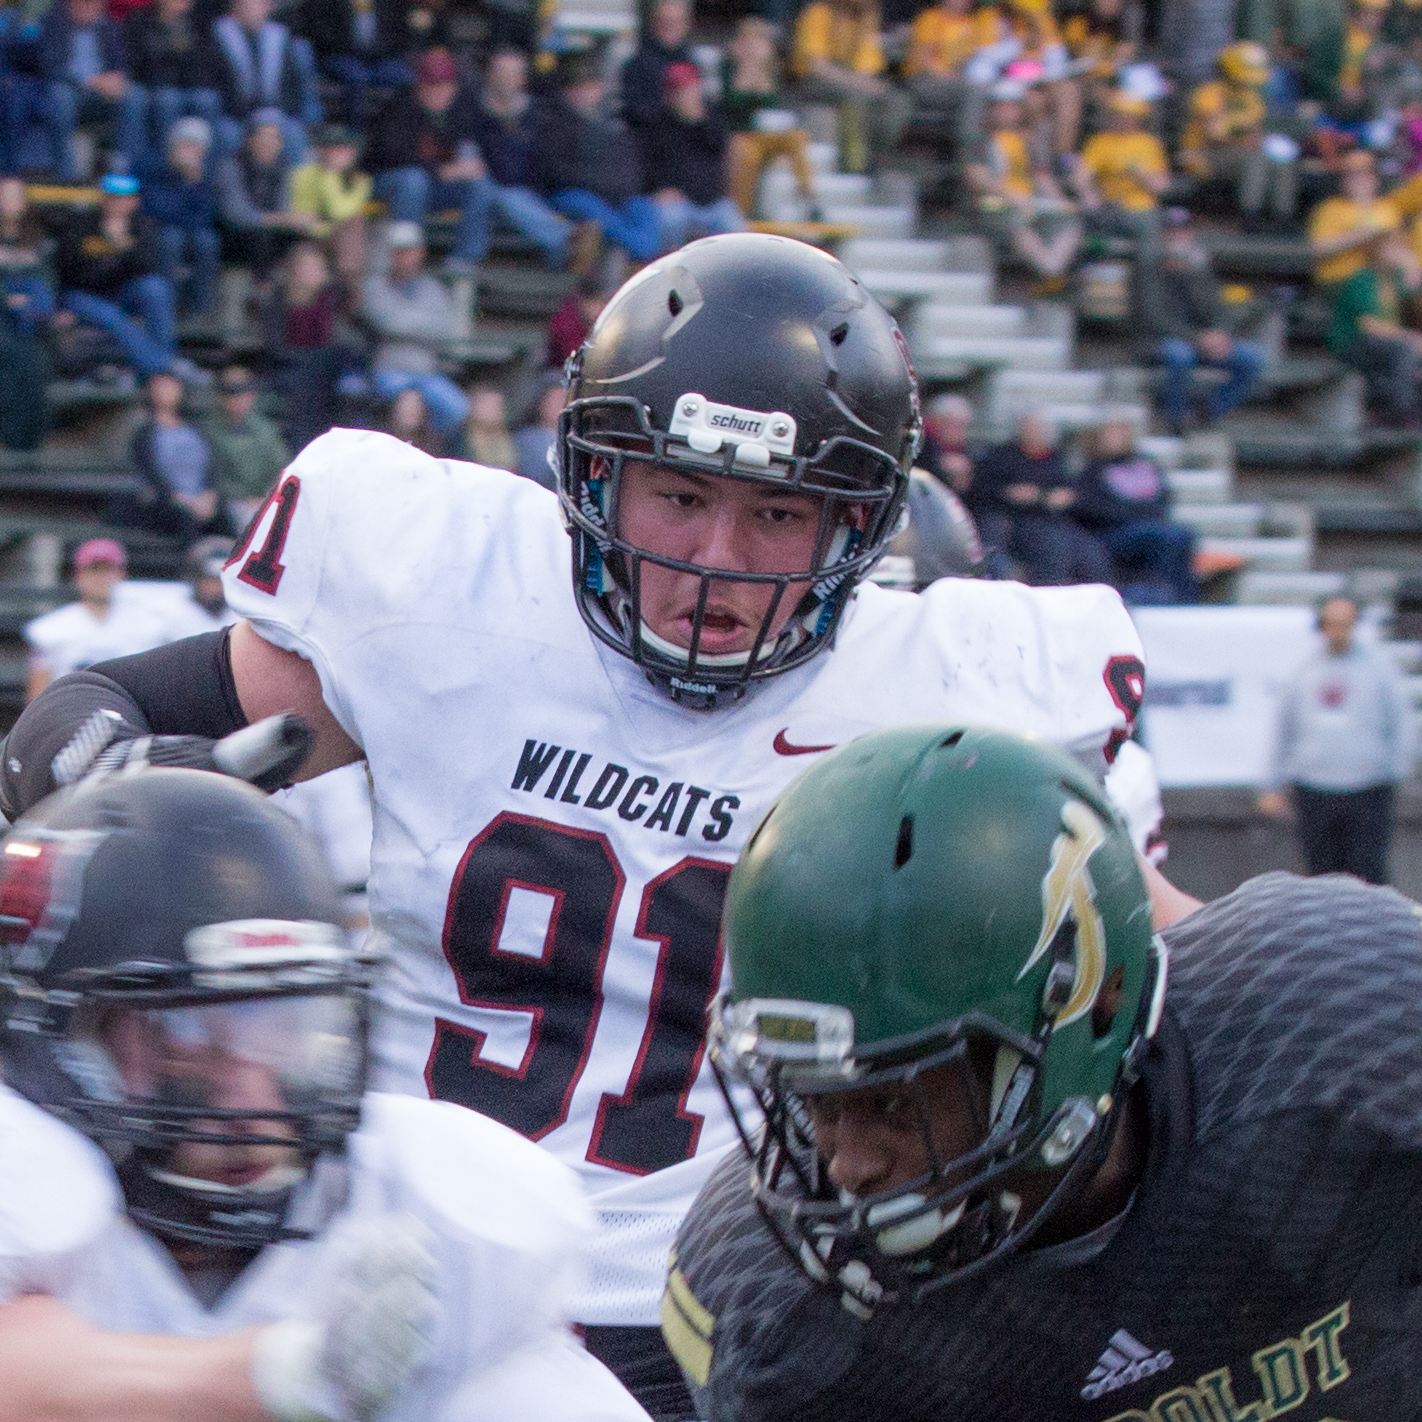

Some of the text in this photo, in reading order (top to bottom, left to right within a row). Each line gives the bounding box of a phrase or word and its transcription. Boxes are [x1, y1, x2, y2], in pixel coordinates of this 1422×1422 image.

[709, 413, 763, 434] schutt
[511, 738, 740, 843] WILDCATS
[424, 810, 736, 1176] 91
